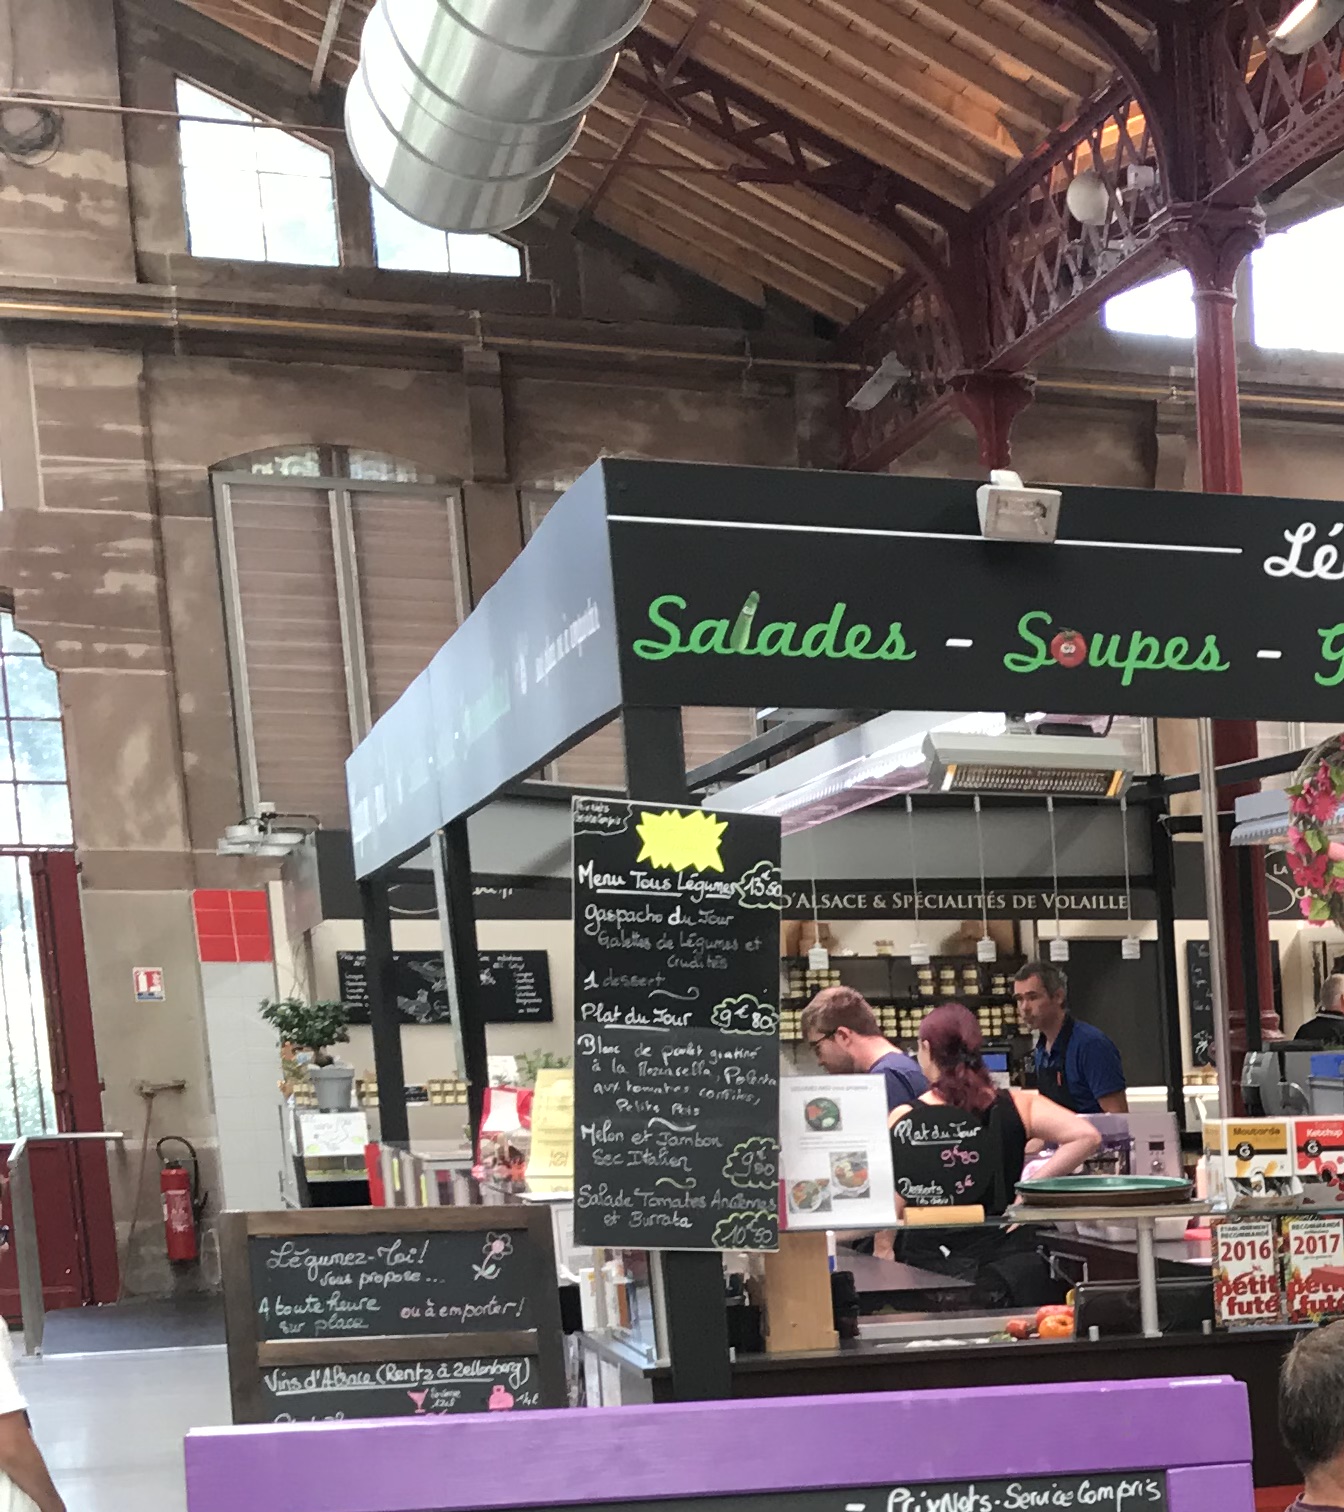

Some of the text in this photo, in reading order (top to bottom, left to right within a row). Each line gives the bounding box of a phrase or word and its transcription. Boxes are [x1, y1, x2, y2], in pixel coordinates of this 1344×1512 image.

[632, 590, 918, 662] Salades
[1003, 610, 1231, 686] Soupes
[578, 860, 736, 903] Menu Tous Légumes
[1013, 894, 1037, 908] DE
[1043, 894, 1128, 909] VOLAILLE
[667, 905, 696, 926] du
[699, 909, 735, 926] Jour
[656, 933, 674, 949] de
[680, 931, 738, 954] Légumes
[745, 940, 763, 951] et
[603, 968, 665, 987] dessert
[581, 1002, 692, 1026] Plat du Jour
[581, 1120, 724, 1148] Melon et Jambon
[894, 1118, 981, 1145] Plat du Jour
[1306, 1128, 1343, 1138] Ketchup
[592, 1150, 624, 1166] Sec
[577, 1183, 634, 1208] Salade
[634, 1187, 706, 1209] Tomates
[603, 1211, 692, 1228] et Burrata
[1221, 1240, 1271, 1262] 2016
[1293, 1234, 1341, 1256] 2017
[275, 1296, 323, 1315] toute
[326, 1291, 381, 1312] heure
[400, 1306, 419, 1319] ou
[425, 1298, 436, 1317] à
[1227, 1294, 1280, 1316] futé
[314, 1315, 369, 1335] place
[264, 1368, 302, 1392] Vins
[438, 1364, 447, 1379] à
